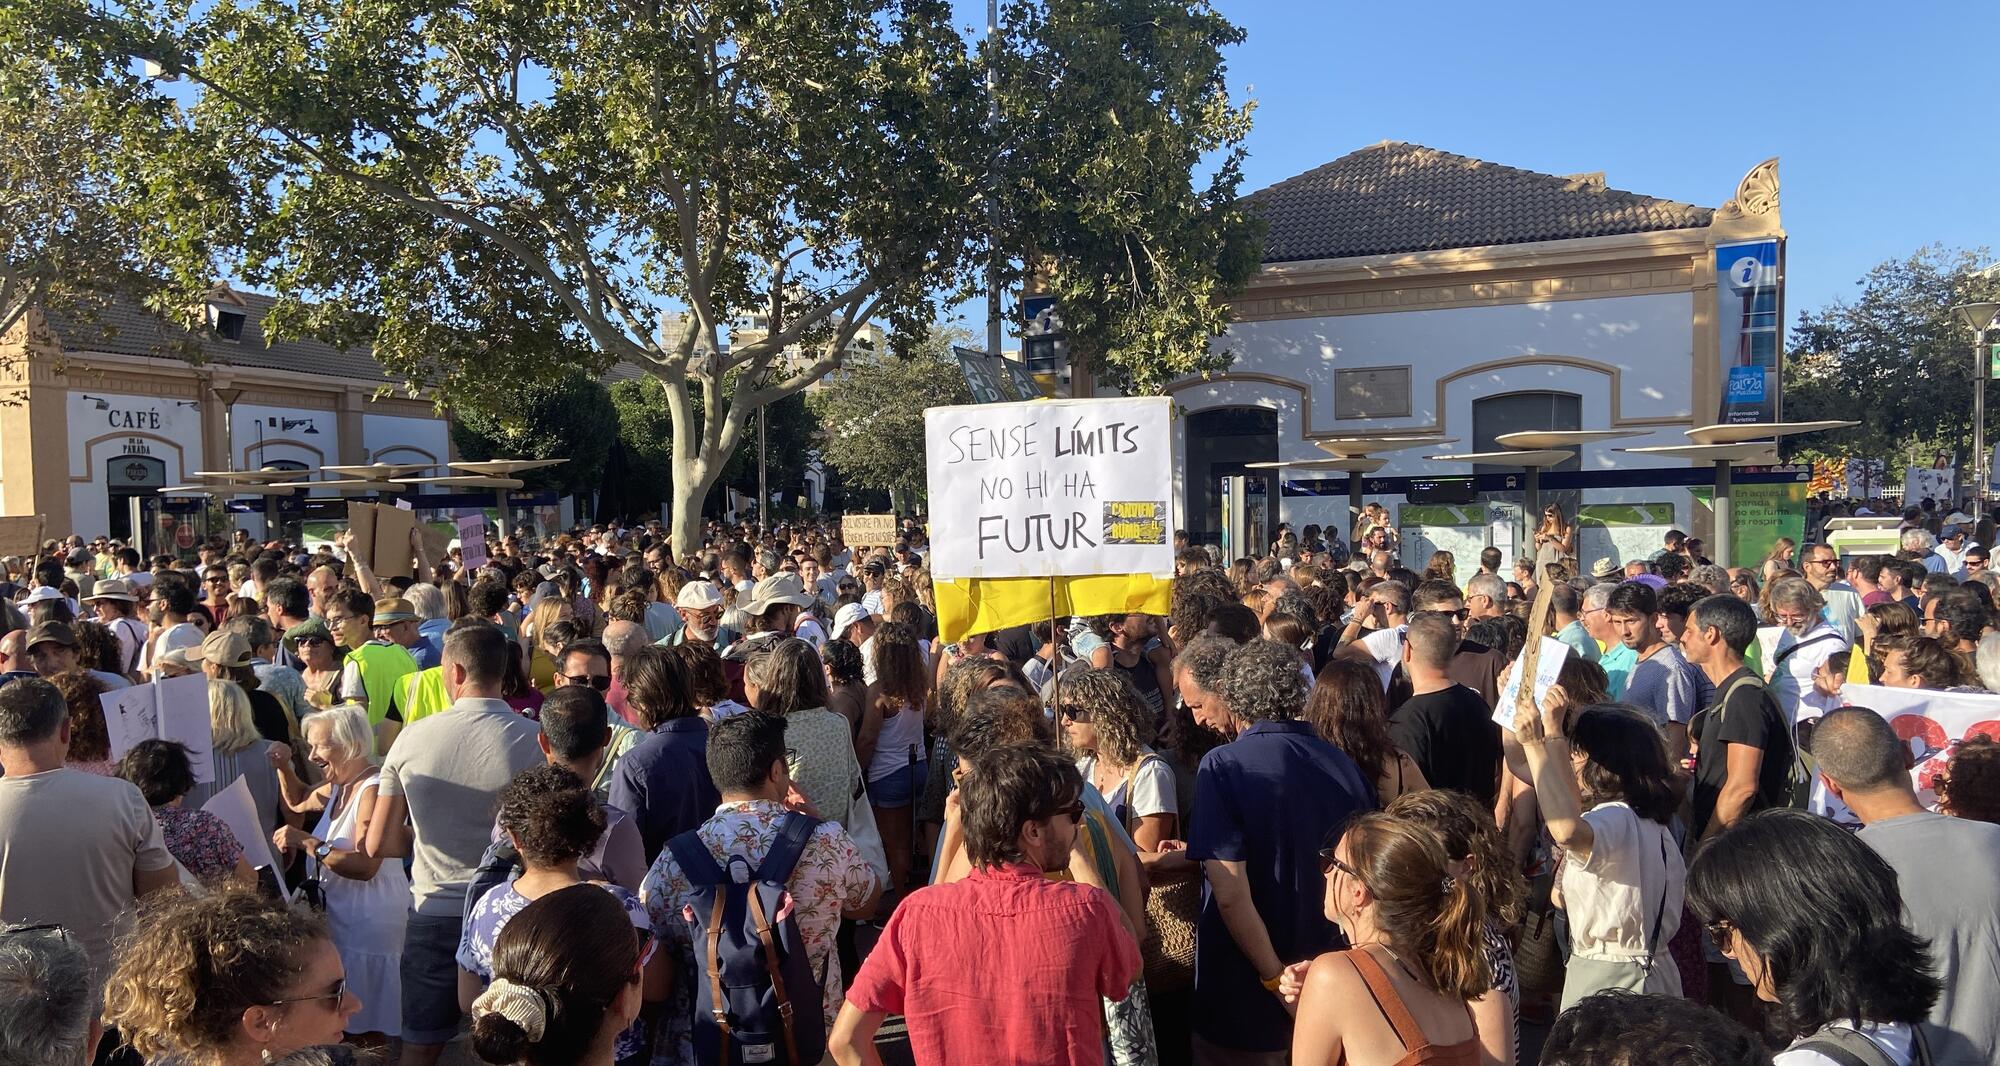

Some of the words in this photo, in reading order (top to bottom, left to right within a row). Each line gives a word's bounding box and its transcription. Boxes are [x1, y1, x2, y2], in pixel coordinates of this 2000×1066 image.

[109, 408, 160, 429] CAFÉ
[947, 421, 1038, 464] SENSE
[1055, 415, 1139, 458] LÍMITS
[123, 445, 150, 455] PARADA
[980, 476, 1013, 504] NO
[1025, 469, 1048, 499] HI
[1064, 470, 1096, 499] HA
[1735, 489, 1748, 498] En
[1735, 499, 1770, 509] parada
[1749, 517, 1783, 527] respira
[978, 511, 1097, 559] FUTUR
